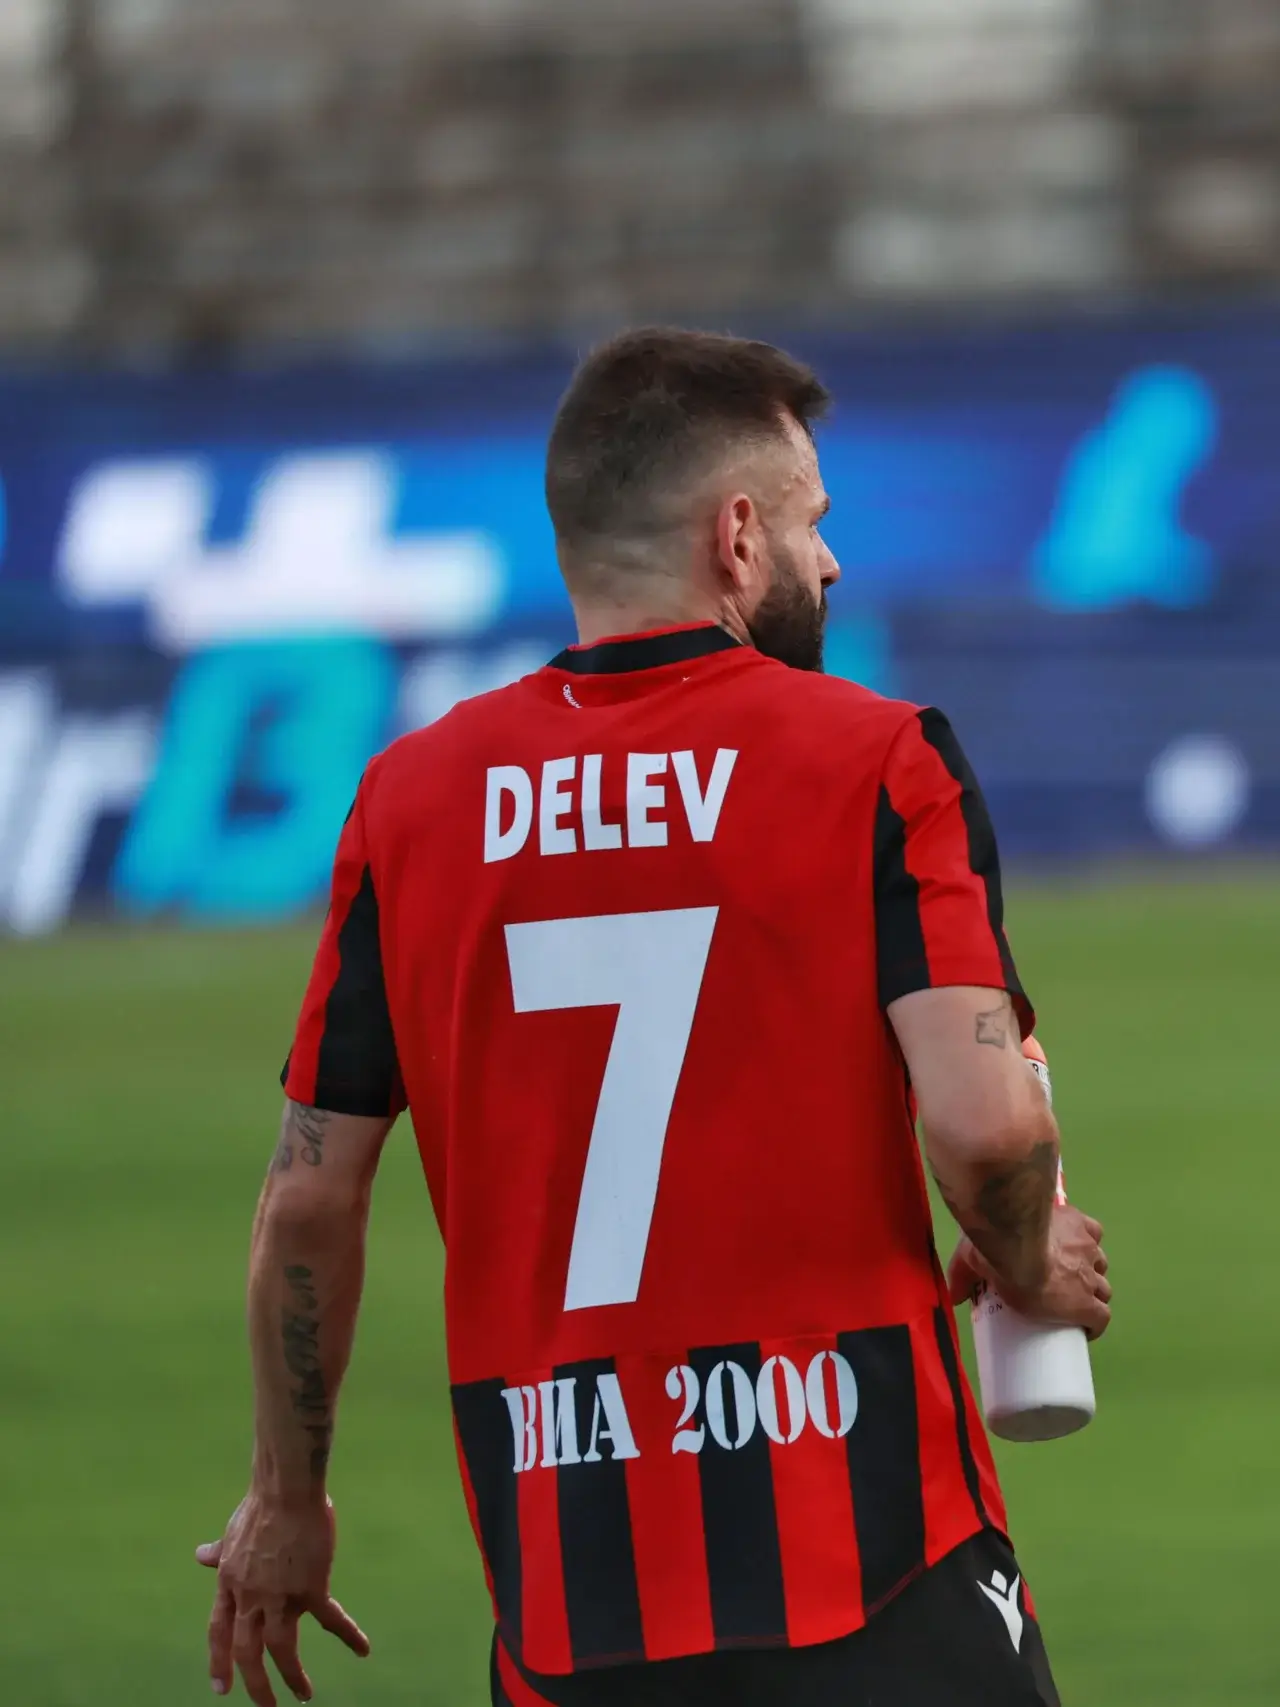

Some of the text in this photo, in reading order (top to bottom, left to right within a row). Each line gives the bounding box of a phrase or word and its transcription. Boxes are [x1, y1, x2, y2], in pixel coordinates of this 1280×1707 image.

[484, 747, 738, 863] DELEV
[504, 906, 719, 1312] 7
[500, 1350, 859, 1474] ВИА 2000
